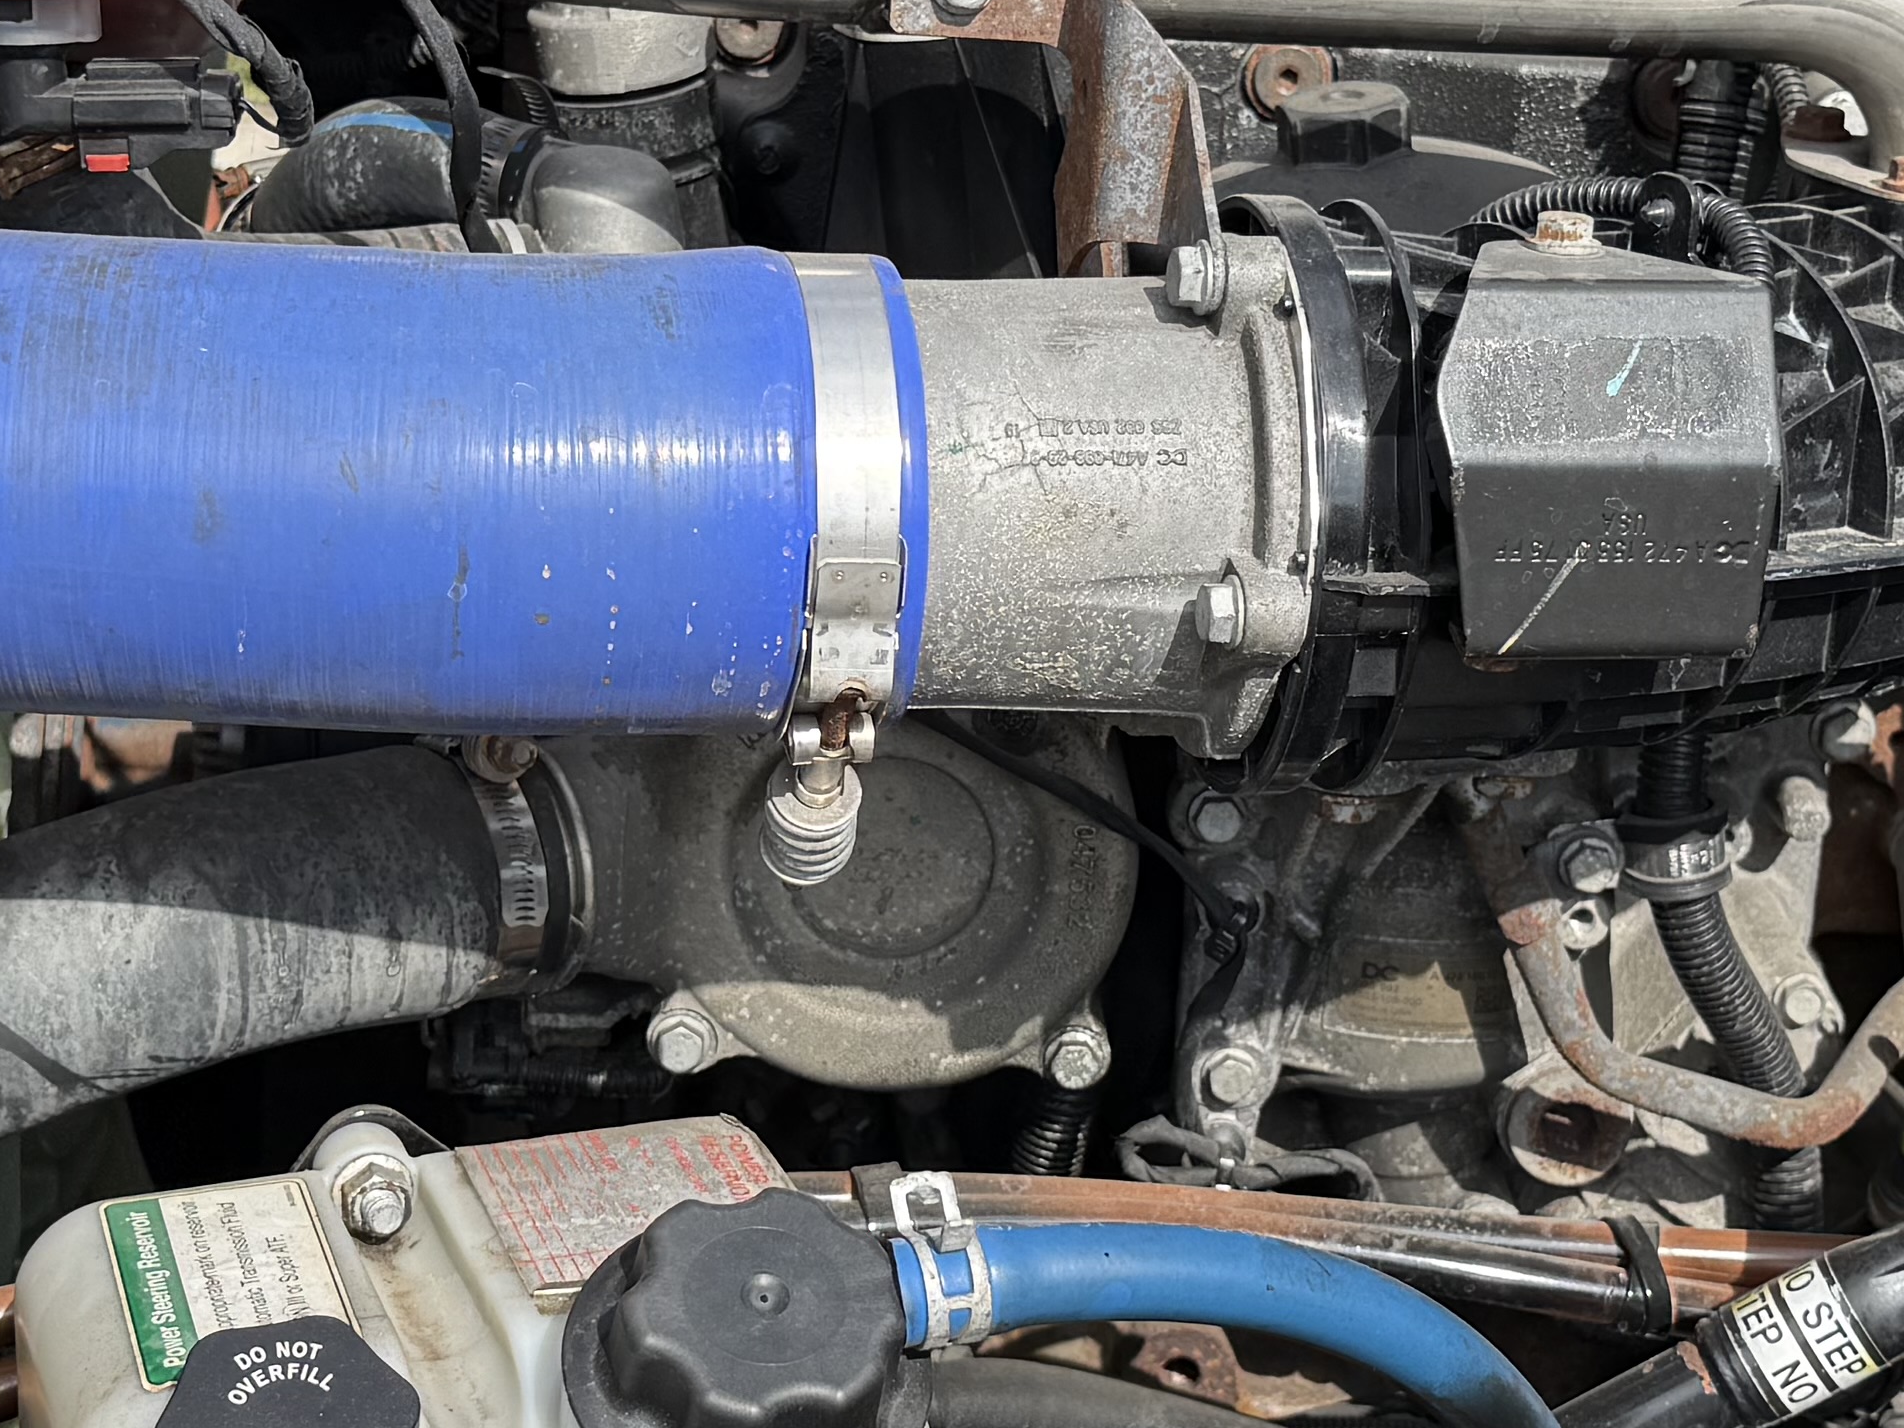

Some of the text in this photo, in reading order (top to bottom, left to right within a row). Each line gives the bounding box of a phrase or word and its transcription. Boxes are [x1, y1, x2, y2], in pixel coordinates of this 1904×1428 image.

[1601, 513, 1646, 536] USA
[216, 1201, 261, 1287] Transmission Fluid
[130, 1210, 188, 1368] Power Steering Reservoir
[273, 1253, 300, 1283] Super
[232, 1341, 323, 1371] DO NOT
[1801, 1301, 1867, 1374] STEP
[227, 1362, 335, 1405] OVERFILL
[1771, 1359, 1818, 1404] NO
